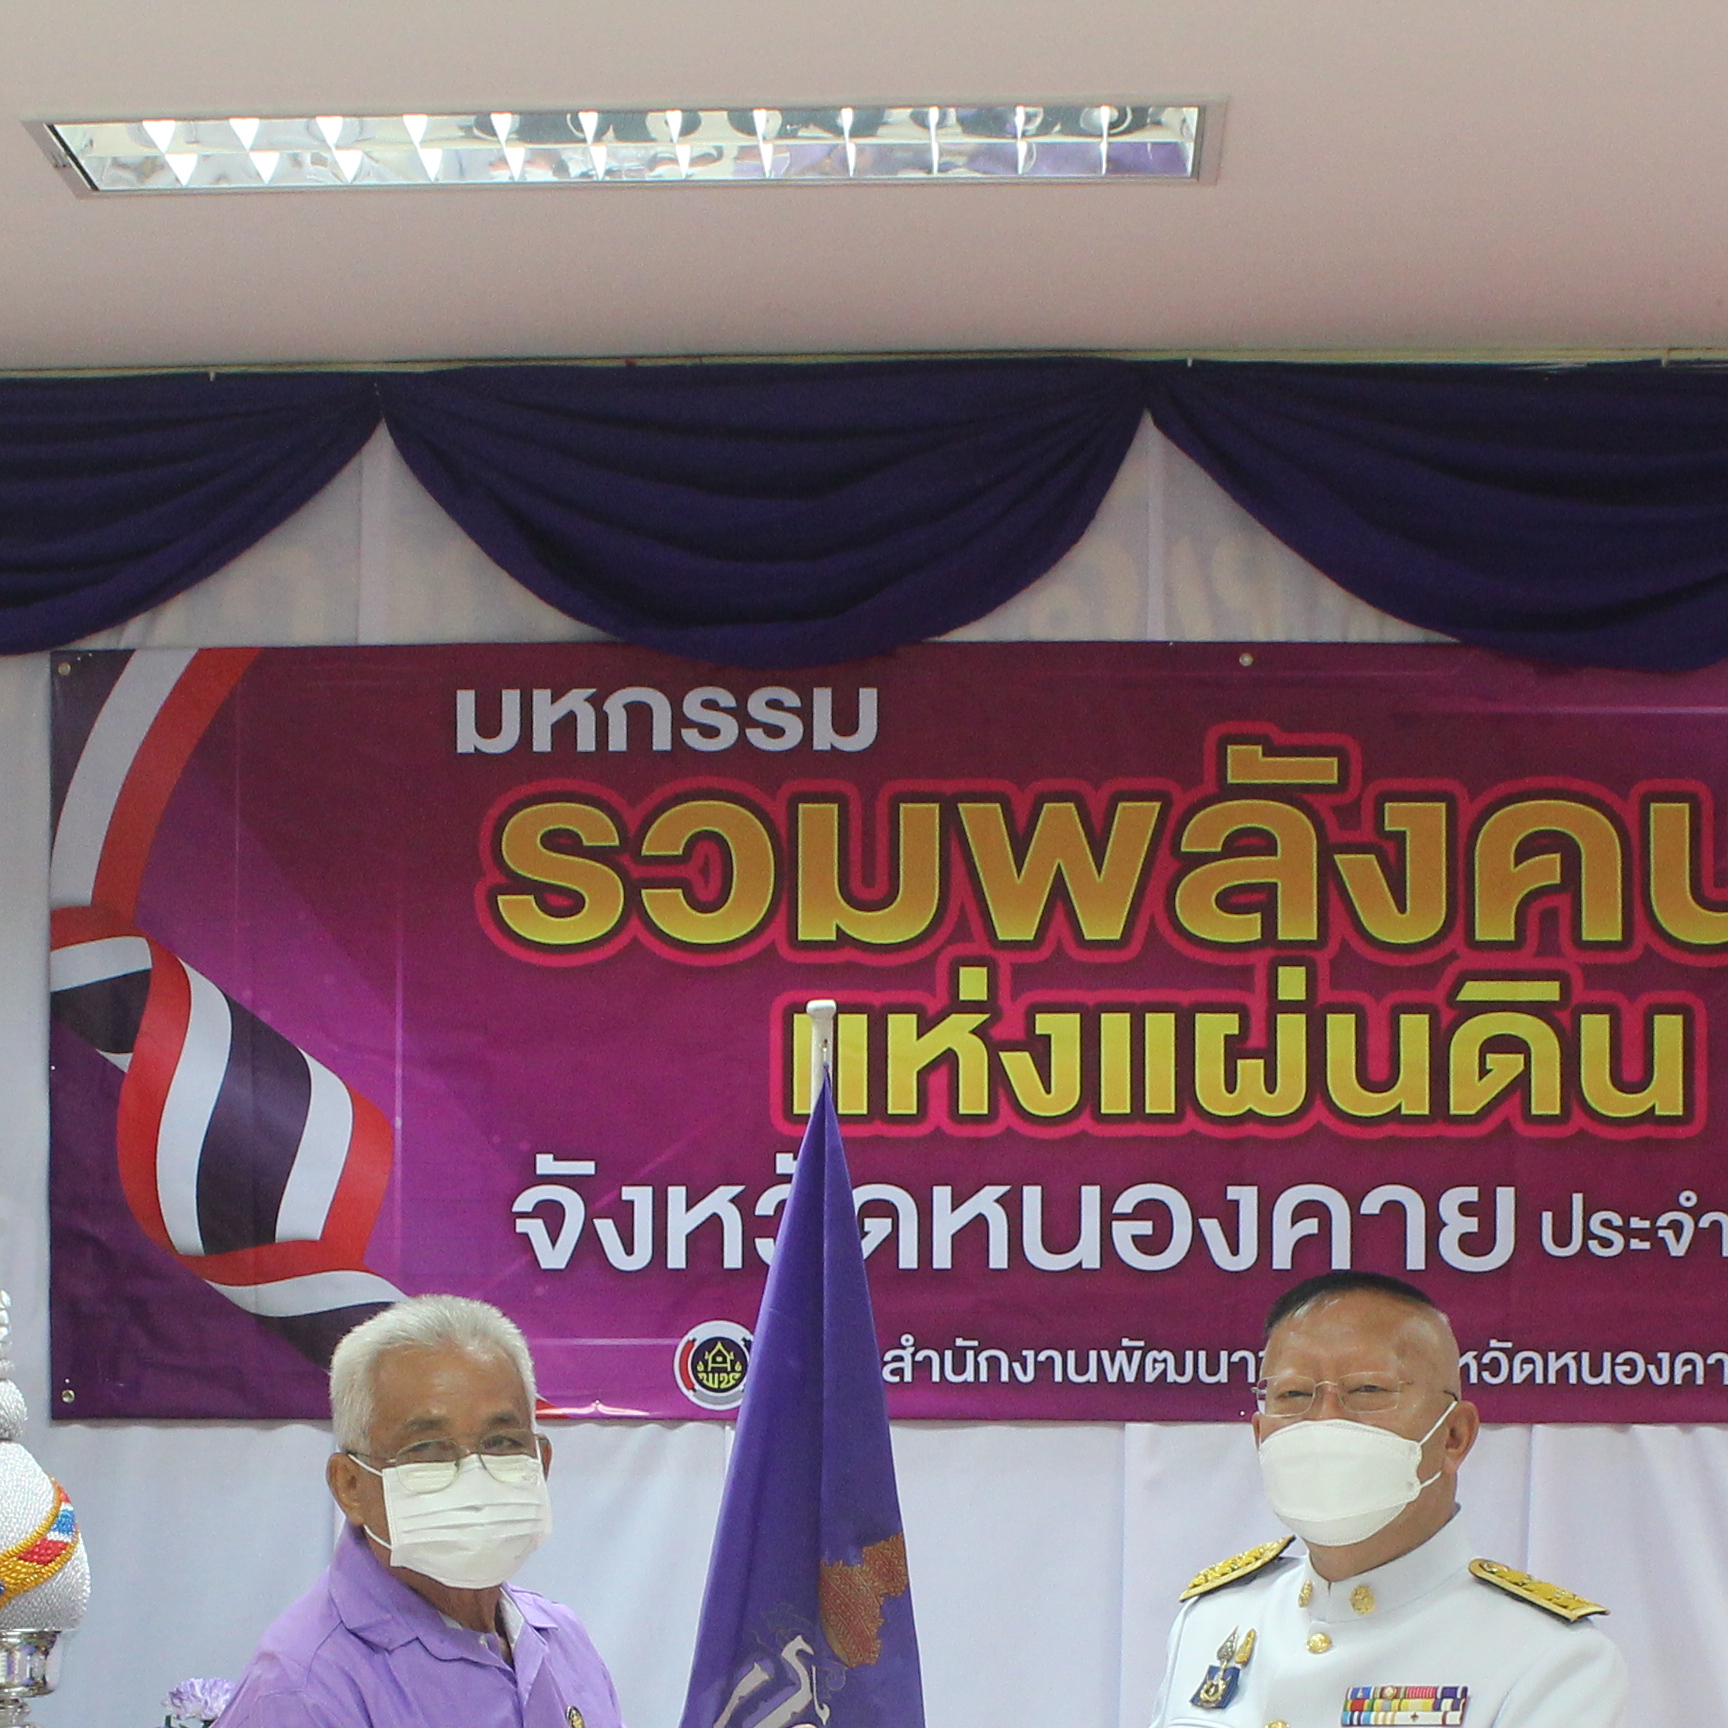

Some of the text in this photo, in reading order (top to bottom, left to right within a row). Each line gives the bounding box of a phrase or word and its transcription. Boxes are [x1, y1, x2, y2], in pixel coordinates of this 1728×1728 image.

[456, 686, 878, 754] มหกรรม
[791, 965, 1685, 1118] แห่งแผ่นดิน
